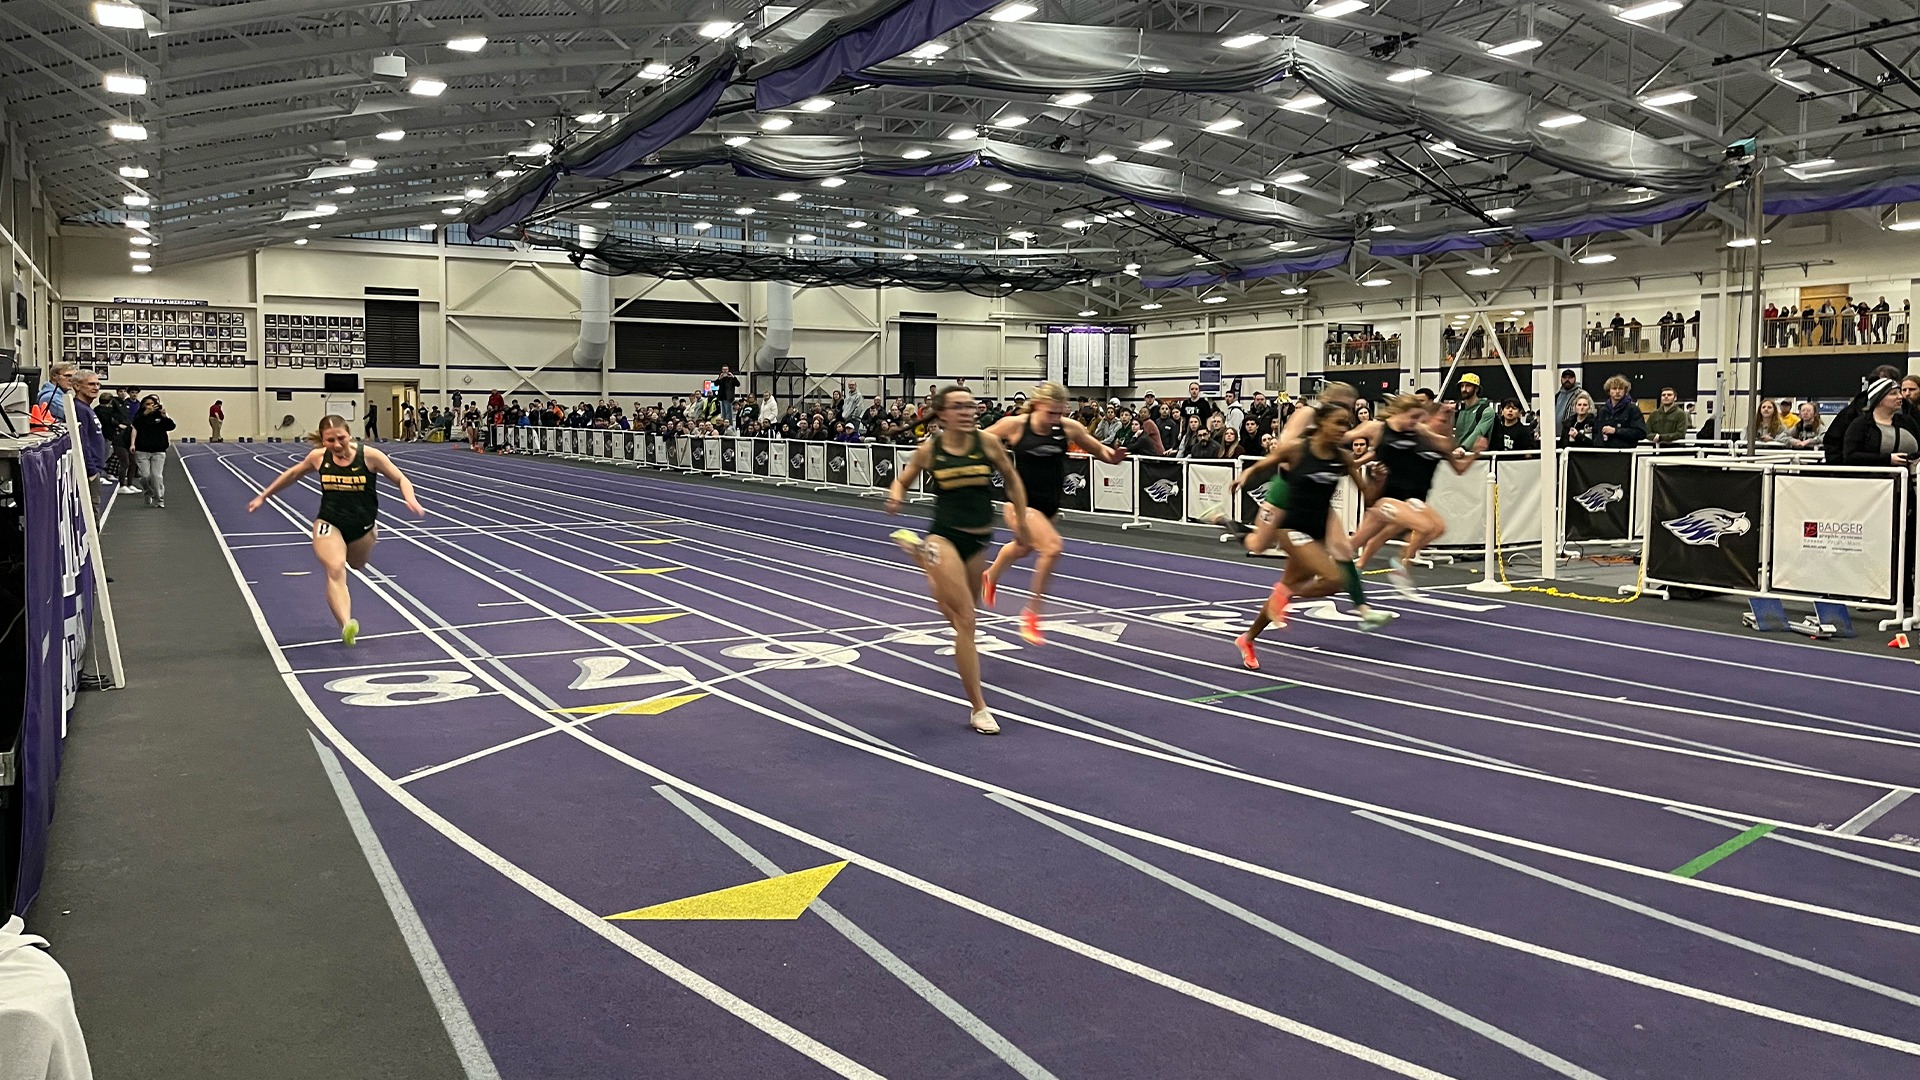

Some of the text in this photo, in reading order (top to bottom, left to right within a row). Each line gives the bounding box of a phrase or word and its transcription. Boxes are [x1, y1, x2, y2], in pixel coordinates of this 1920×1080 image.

[1819, 522, 1862, 533] BADGER
[720, 641, 861, 670] 6
[323, 670, 480, 707] 8
[567, 656, 697, 690] 7
